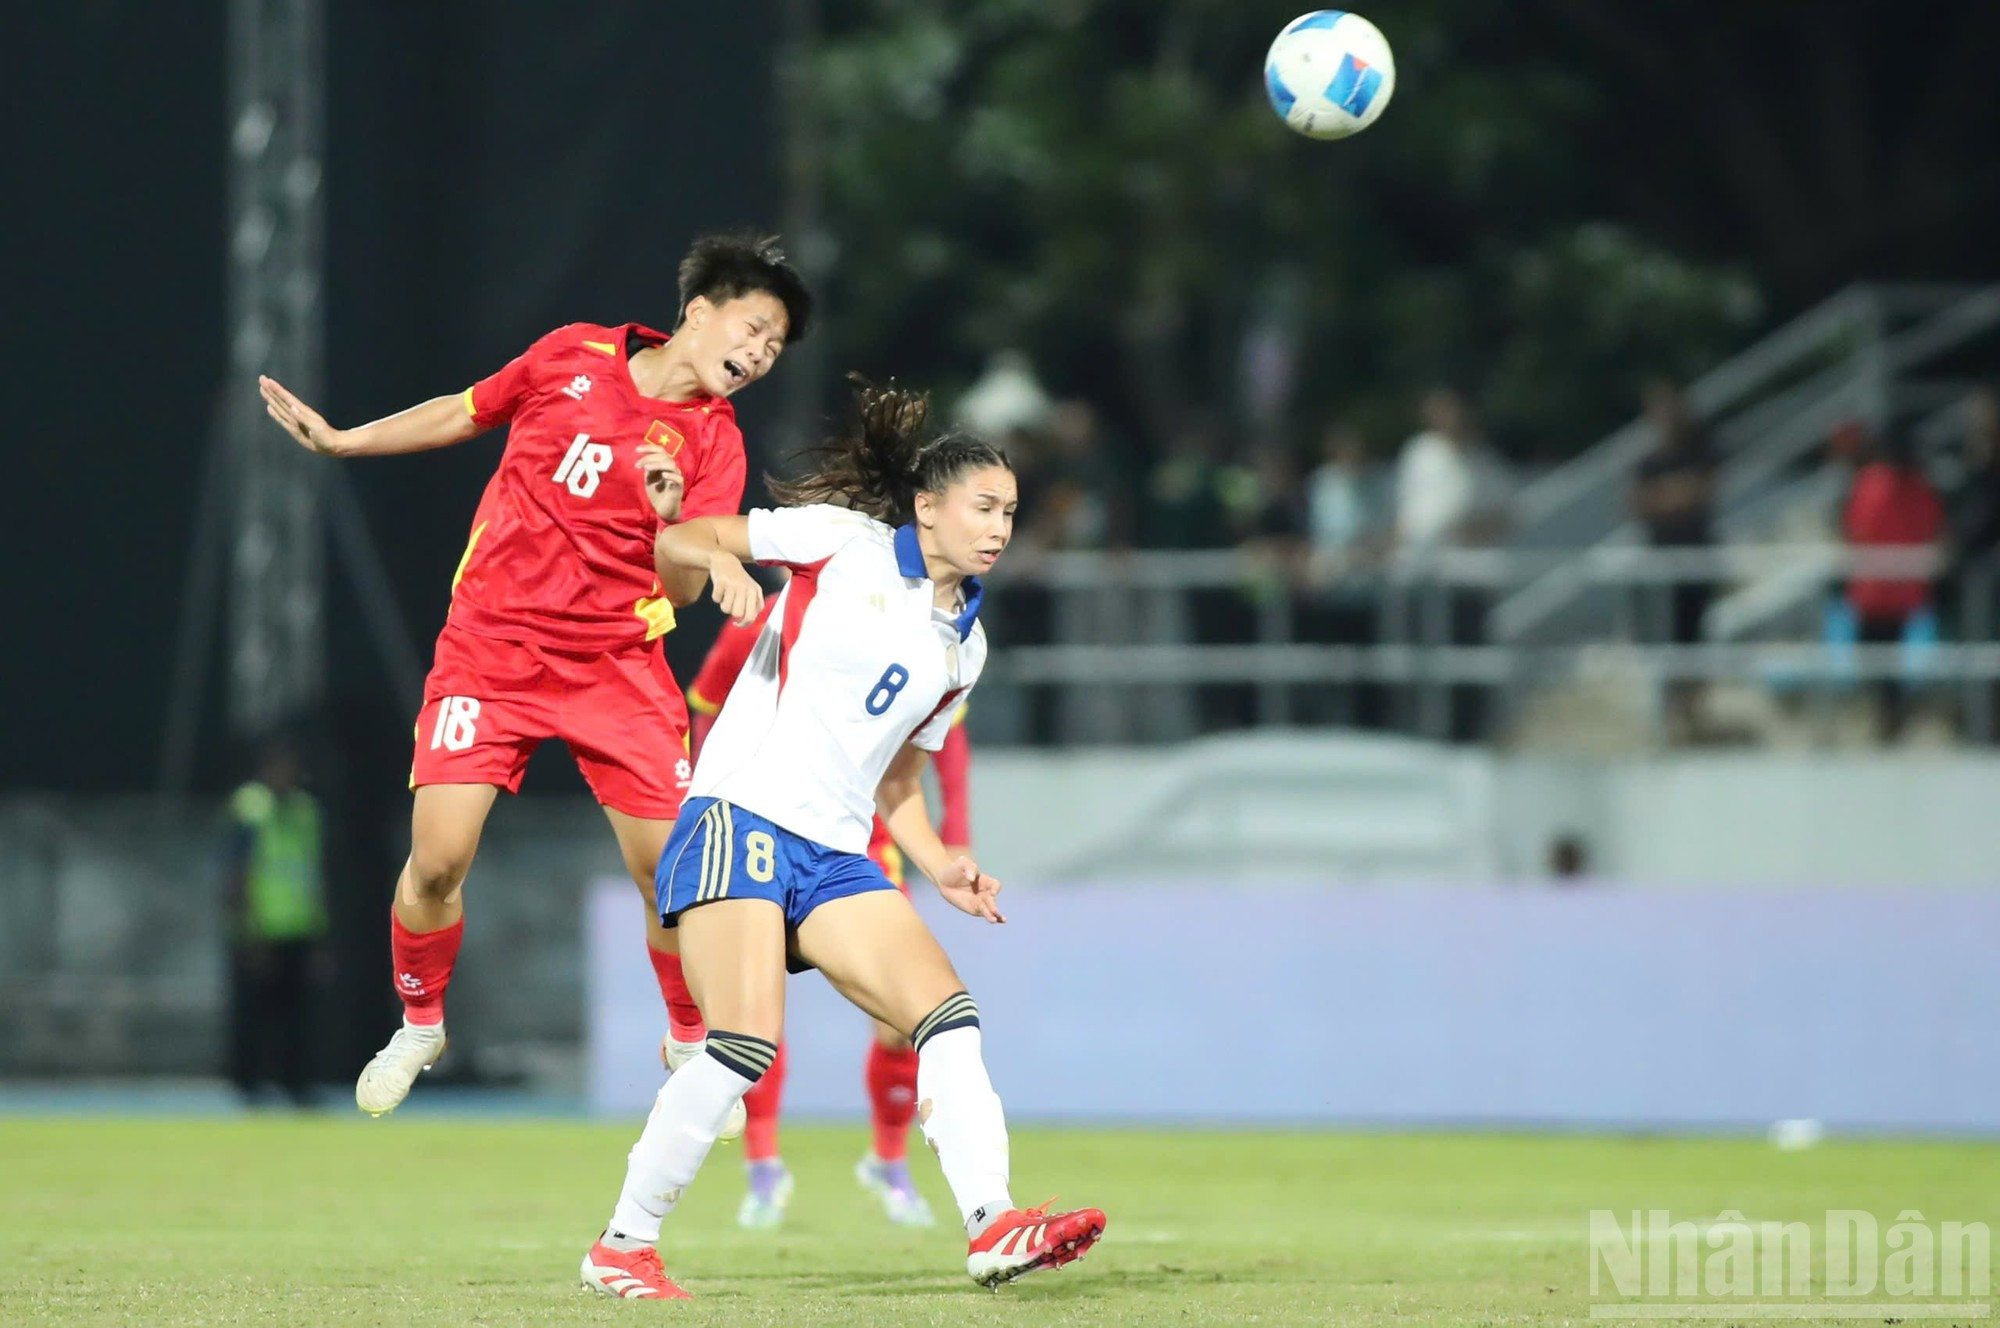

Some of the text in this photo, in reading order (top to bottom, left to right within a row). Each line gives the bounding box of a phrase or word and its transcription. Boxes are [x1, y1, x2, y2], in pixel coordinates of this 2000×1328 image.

[551, 432, 614, 499] 18
[865, 662, 909, 716] 8
[430, 695, 481, 752] 18
[746, 830, 775, 883] 8
